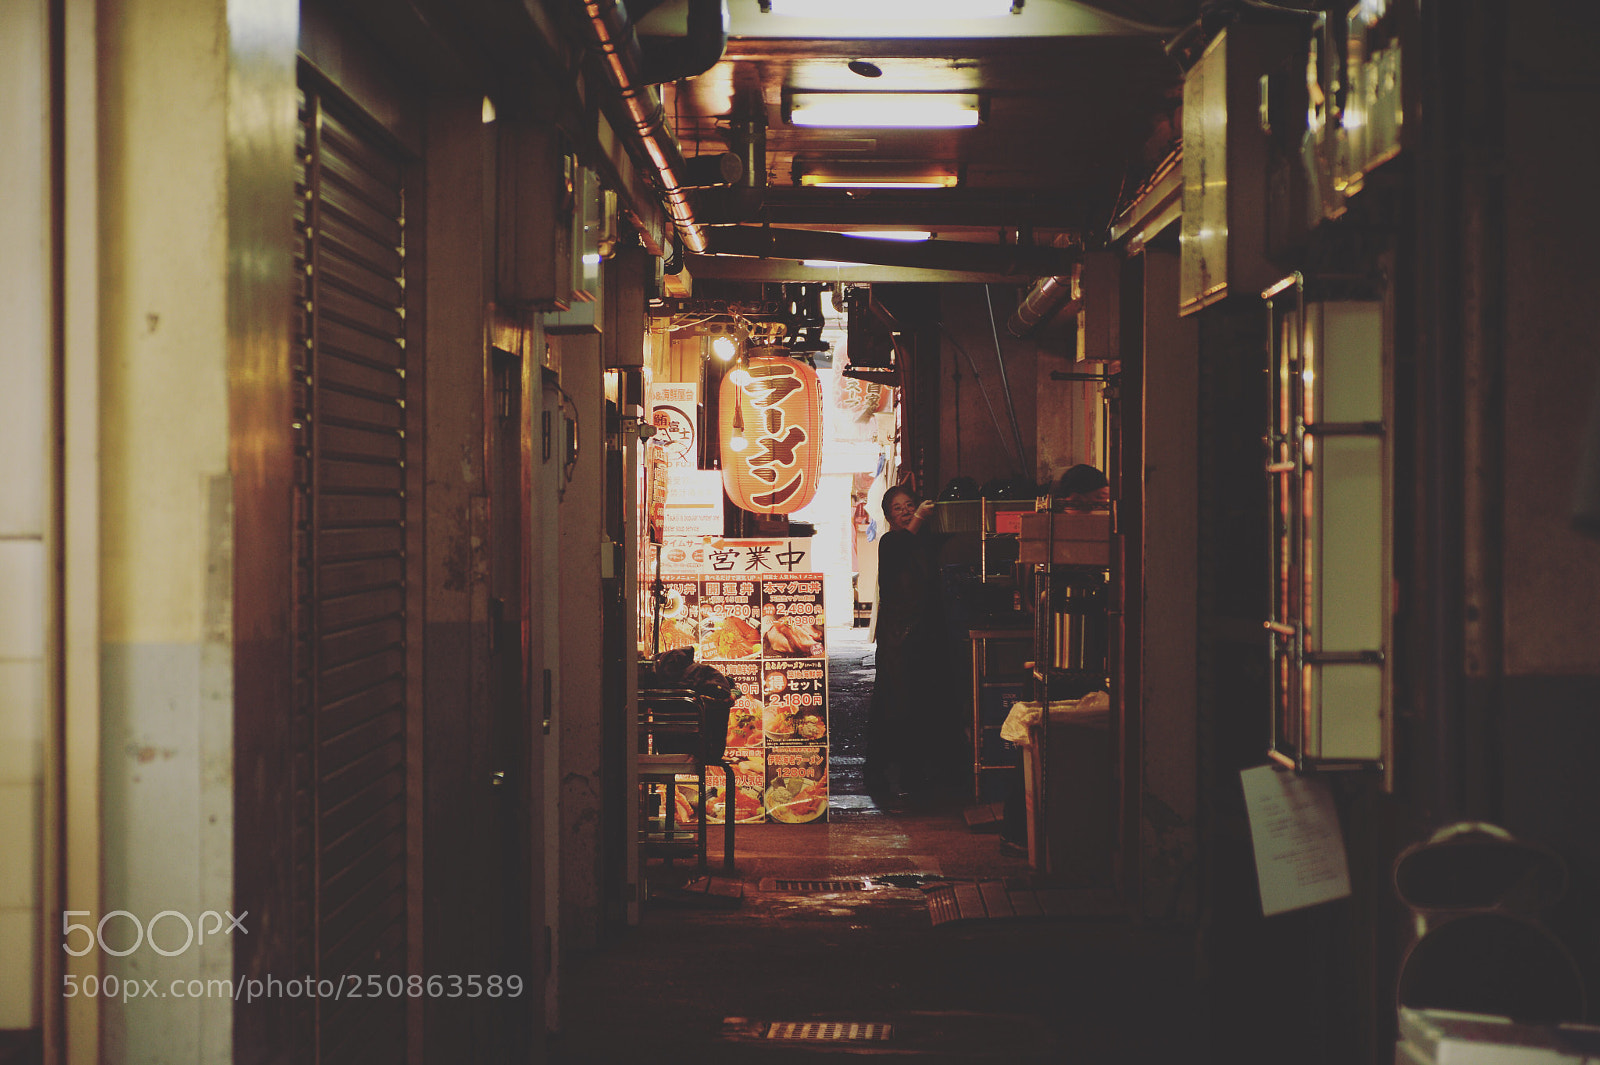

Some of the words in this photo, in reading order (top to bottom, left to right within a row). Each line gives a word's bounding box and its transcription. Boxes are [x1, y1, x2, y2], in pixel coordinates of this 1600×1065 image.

[744, 364, 807, 507] ラーメン
[708, 541, 806, 572] 営業中
[705, 582, 754, 596] 開運丼
[763, 581, 821, 594] 本マグロ丼
[776, 603, 823, 616] 2,480円
[787, 680, 823, 690] セット
[769, 693, 823, 707] 2,180円
[776, 767, 815, 778] 1280円
